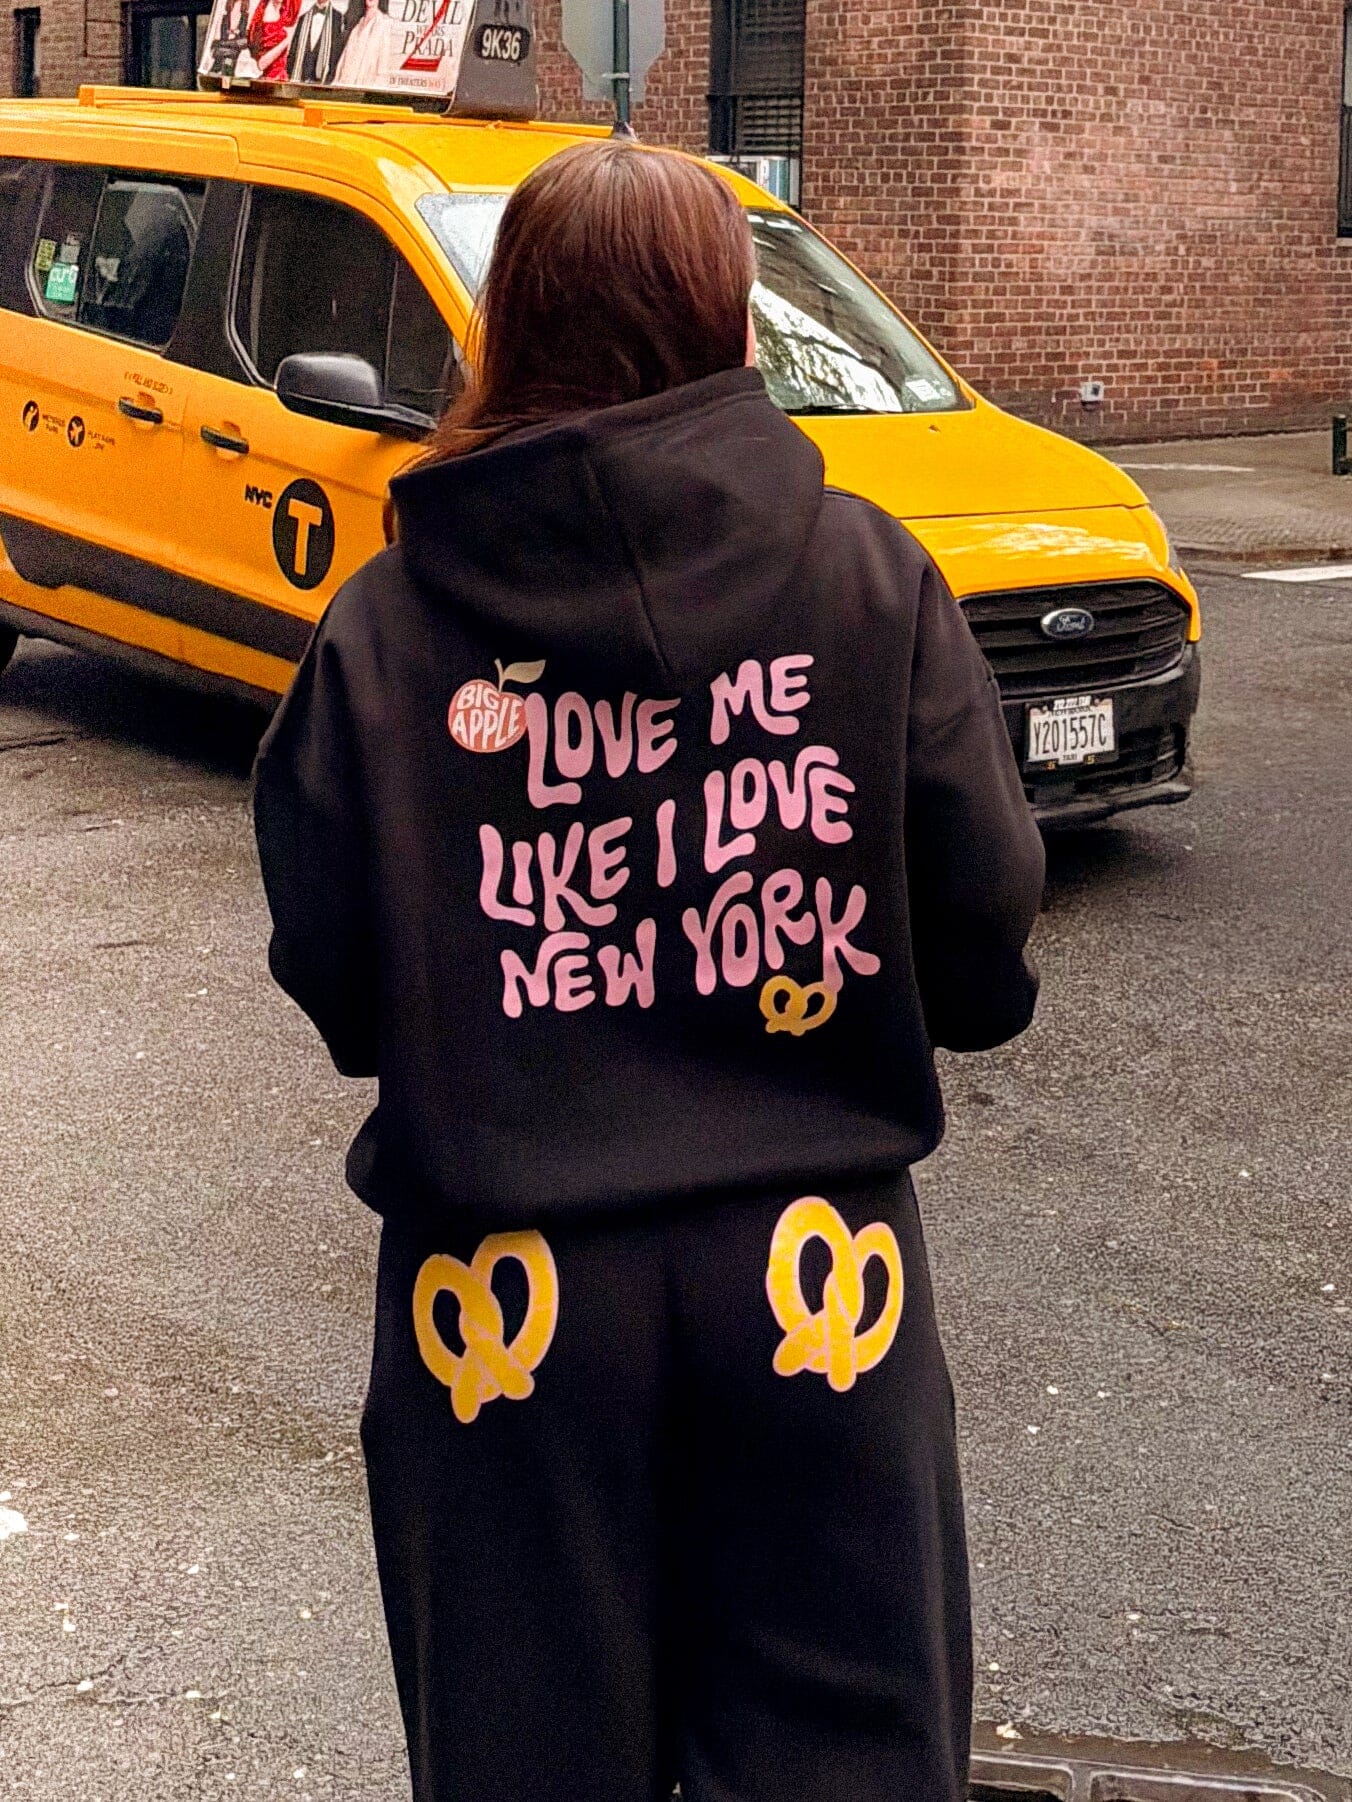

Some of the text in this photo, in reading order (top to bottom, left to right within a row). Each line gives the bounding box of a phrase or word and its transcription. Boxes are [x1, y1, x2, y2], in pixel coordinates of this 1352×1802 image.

[401, 30, 454, 57] PRADA
[481, 28, 522, 61] 9K36
[244, 483, 323, 576] NYC T
[1056, 614, 1087, 632] Ford
[456, 683, 500, 710] BIG
[451, 697, 524, 750] APPLE
[525, 654, 814, 809] LOVE ME
[1033, 712, 1108, 756] Y201557C
[479, 745, 856, 932] LIKE I LOVE
[500, 868, 881, 1018] NEW YORK
